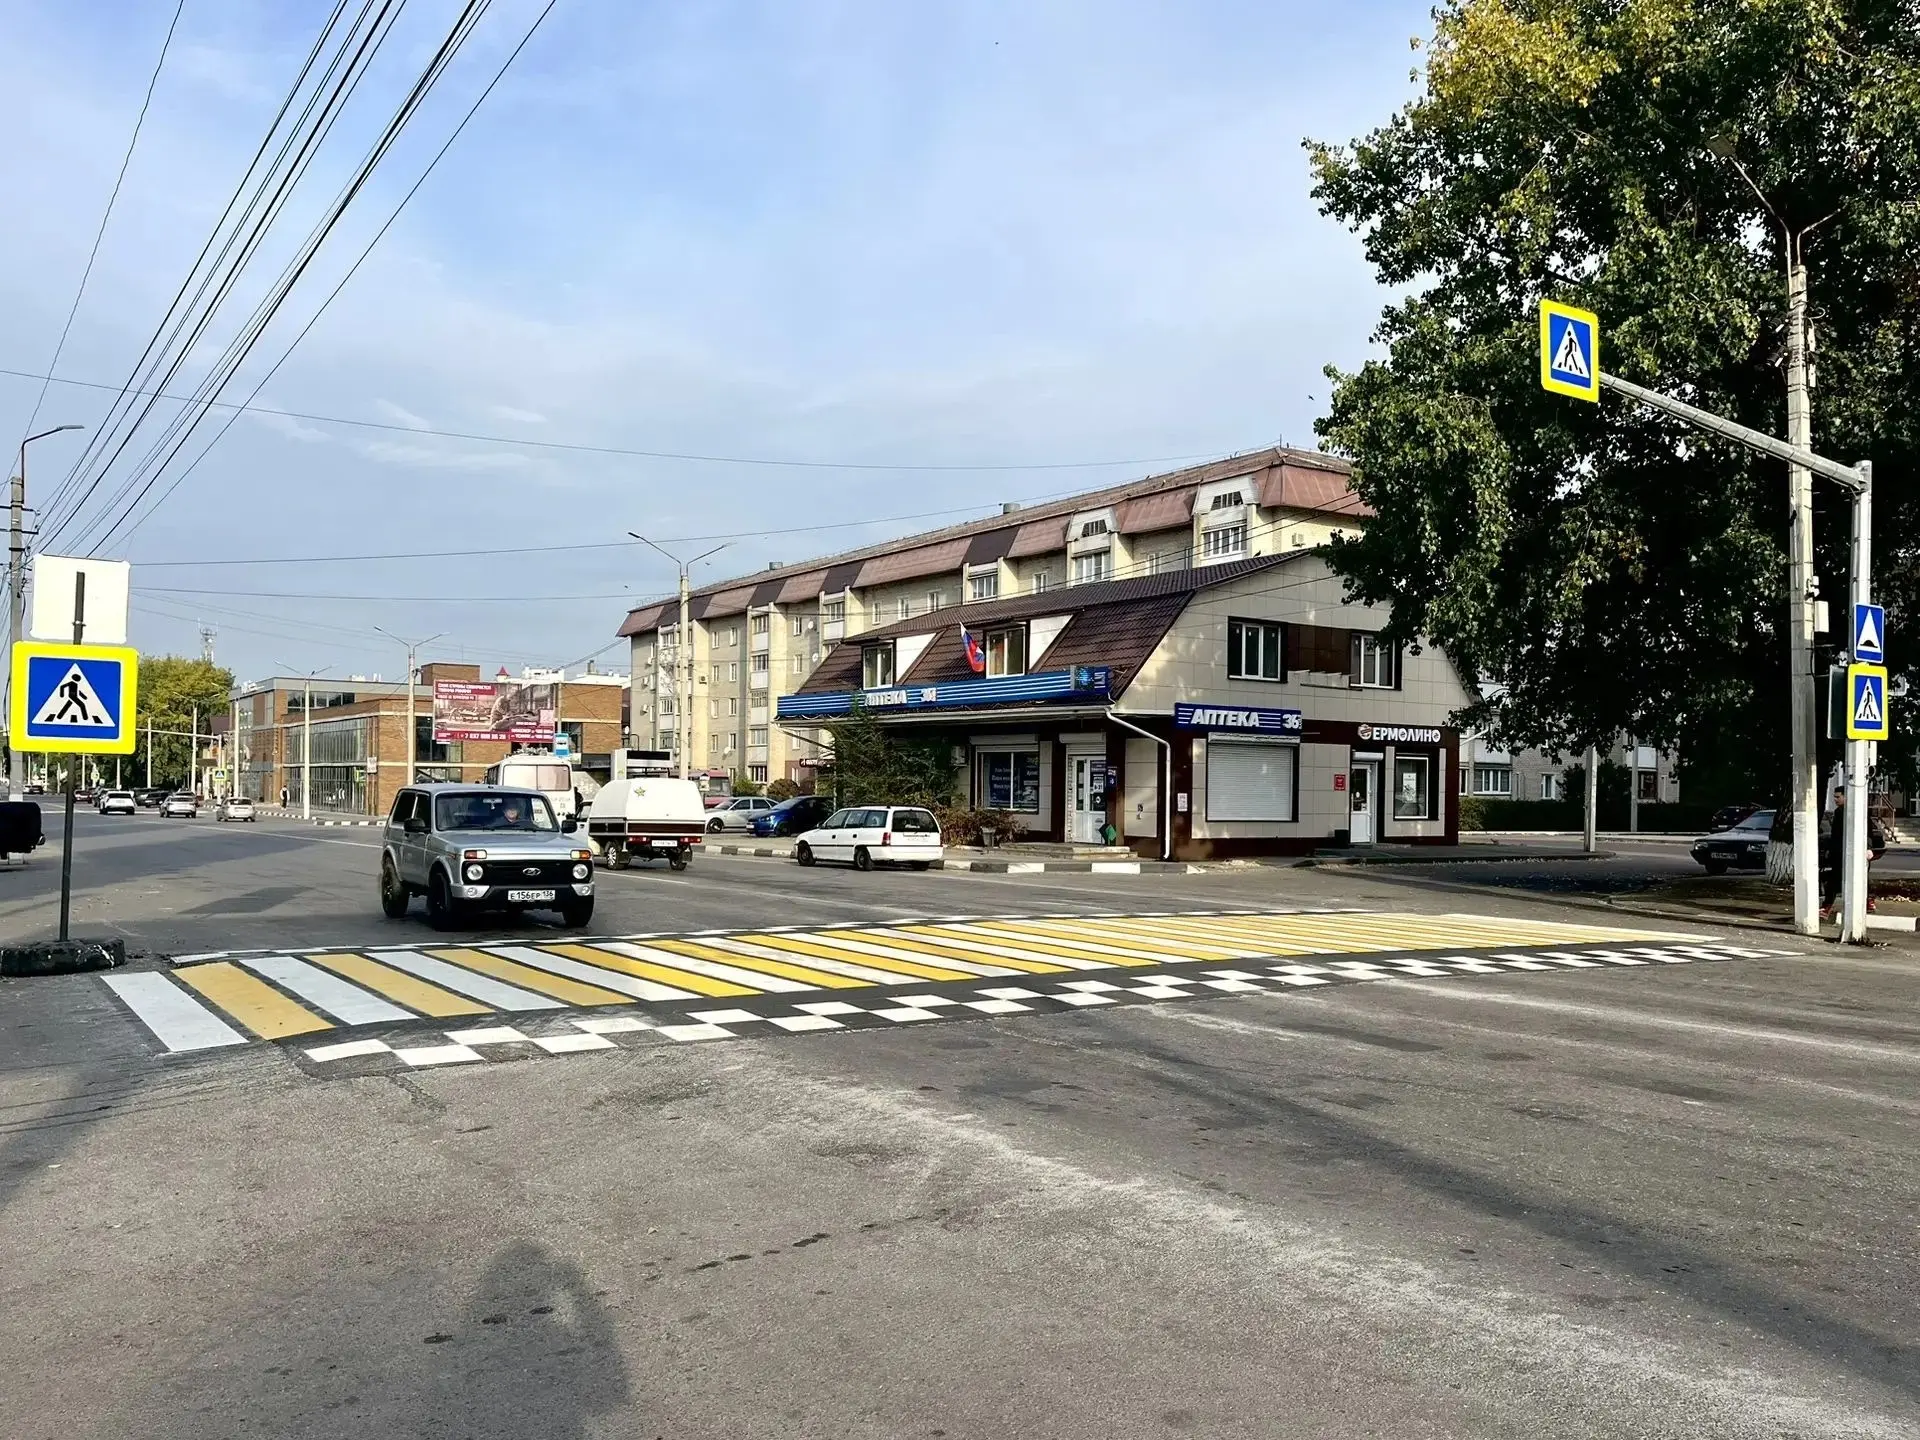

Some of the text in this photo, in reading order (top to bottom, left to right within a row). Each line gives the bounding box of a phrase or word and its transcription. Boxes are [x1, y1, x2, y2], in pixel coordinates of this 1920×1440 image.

[864, 690, 908, 707] АПТЕКА
[1190, 709, 1261, 728] АПТЕКА
[1372, 727, 1441, 743] ЕРМОЛИНО
